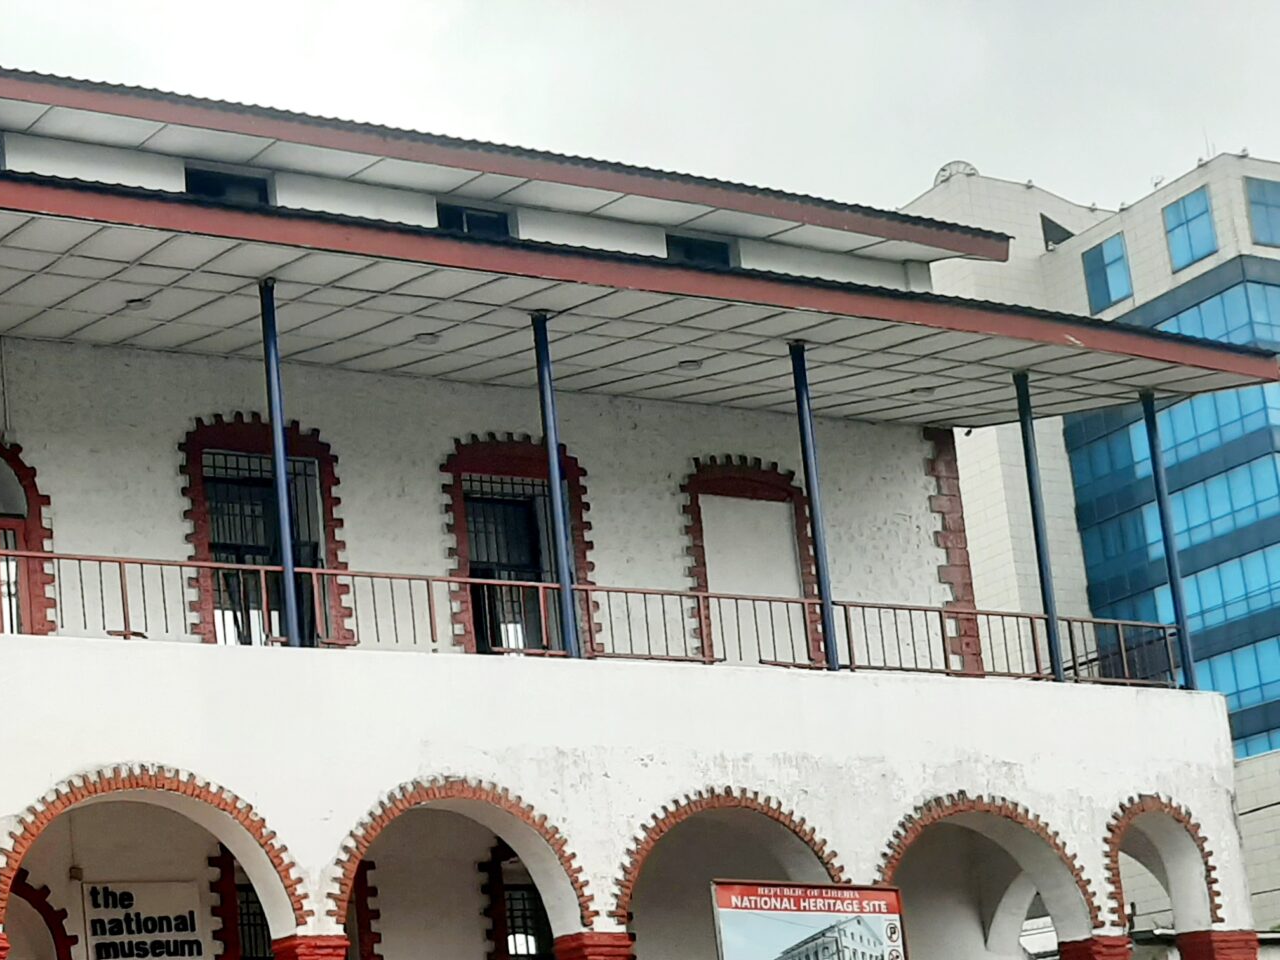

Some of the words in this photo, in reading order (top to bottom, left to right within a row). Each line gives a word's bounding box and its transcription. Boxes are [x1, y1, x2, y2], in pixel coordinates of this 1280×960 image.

[90, 886, 133, 908] the
[731, 895, 798, 910] NATIONAL
[800, 898, 861, 912] HERITAGE
[862, 900, 888, 913] SITE
[757, 887, 805, 896] REPUBLIC
[807, 888, 820, 897] OF
[822, 889, 860, 899] LIBERIA
[91, 910, 196, 936] national
[95, 938, 203, 960] museum
